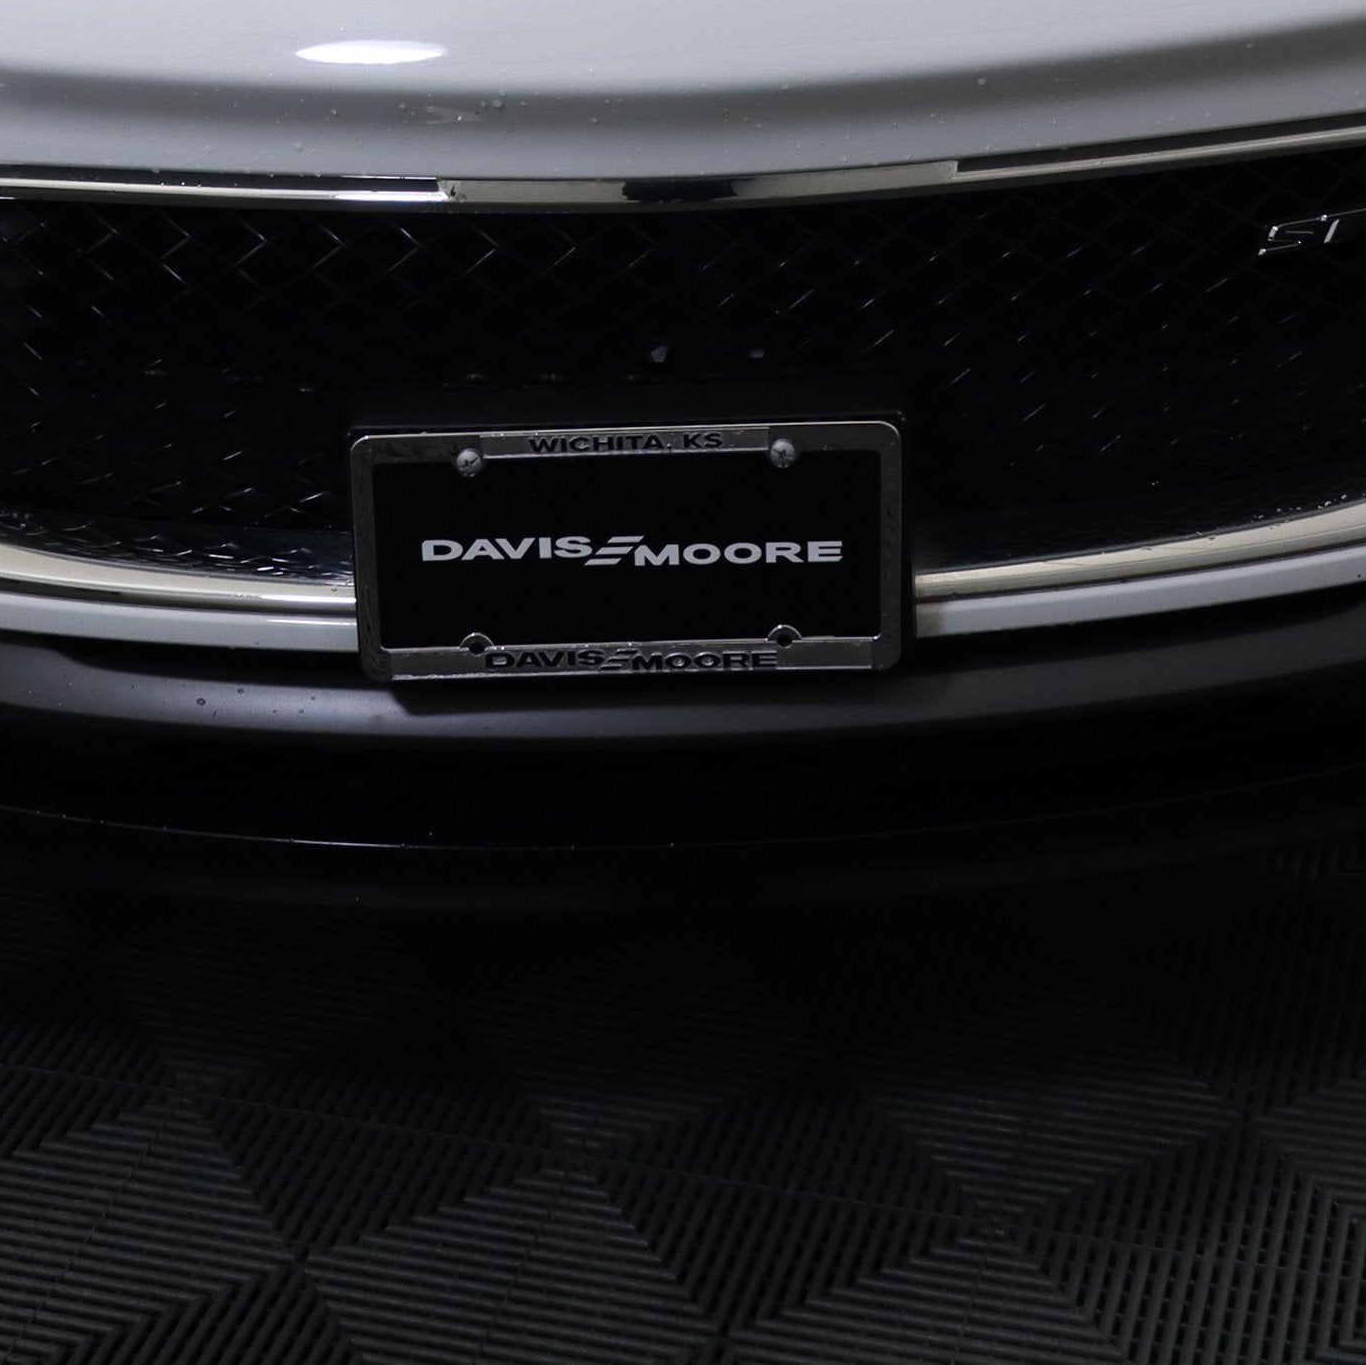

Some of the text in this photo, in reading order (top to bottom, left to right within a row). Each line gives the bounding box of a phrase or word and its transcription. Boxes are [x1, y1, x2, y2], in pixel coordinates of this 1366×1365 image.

[683, 432, 724, 449] KS
[422, 536, 844, 567] DAVIS MOORE
[485, 648, 778, 672] DAVIS MOORE
